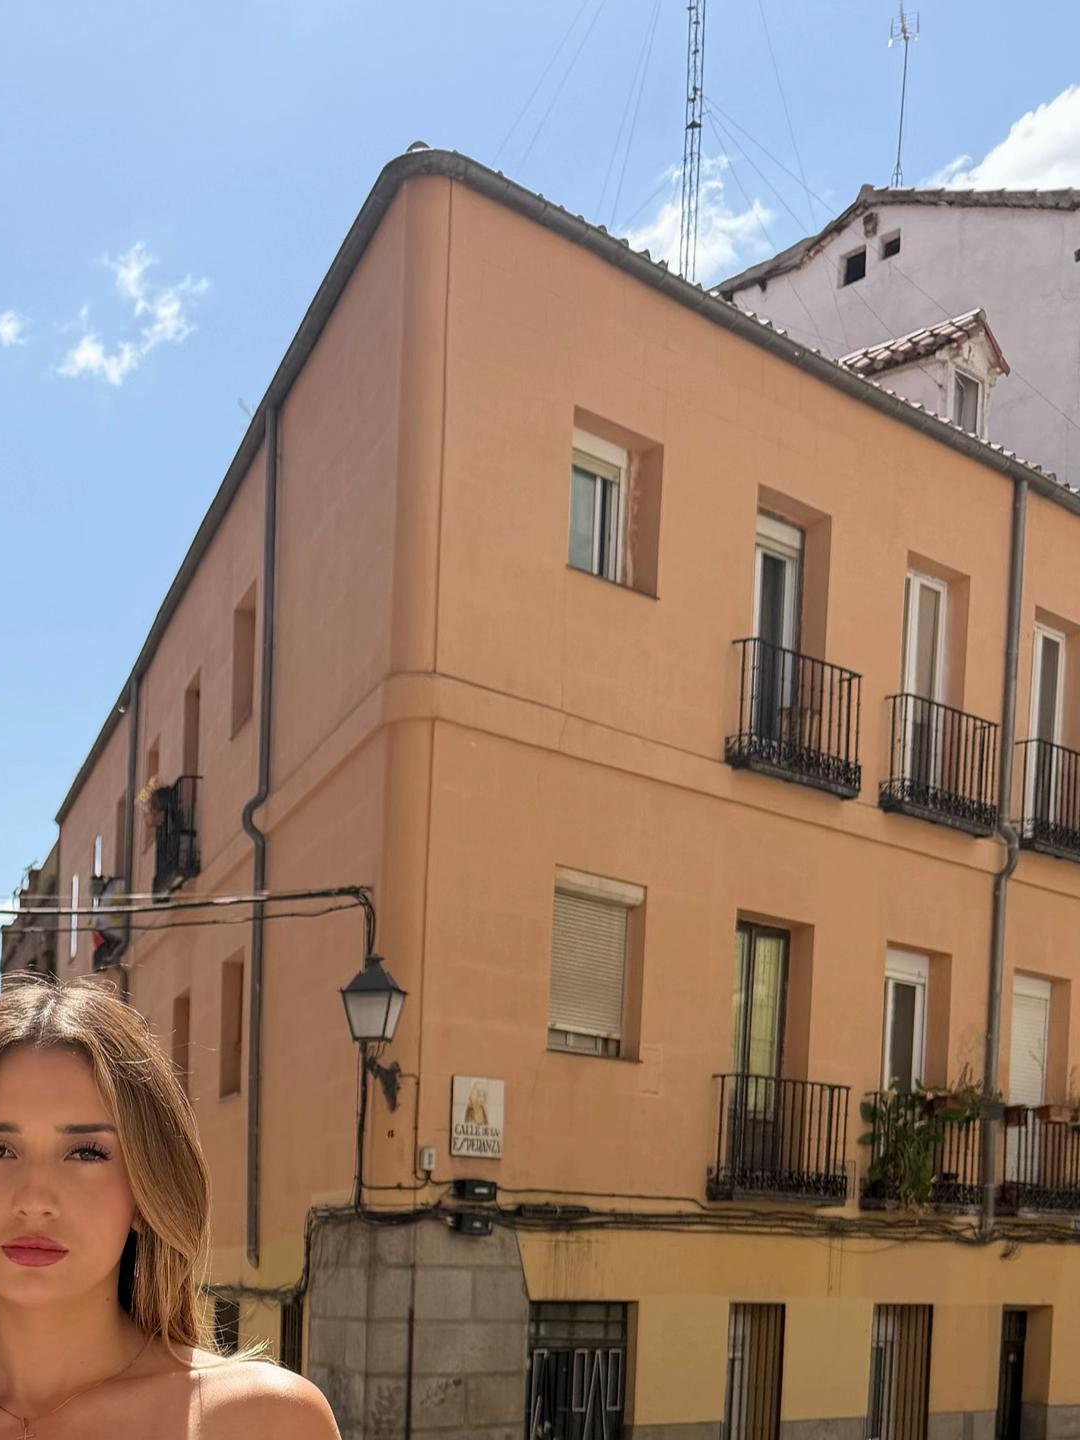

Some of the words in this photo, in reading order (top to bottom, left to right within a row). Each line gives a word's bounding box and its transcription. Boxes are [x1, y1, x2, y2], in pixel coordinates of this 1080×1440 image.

[454, 1123, 481, 1137] CALLE
[490, 1127, 500, 1137] LA
[452, 1136, 501, 1154] ESPERANZA
